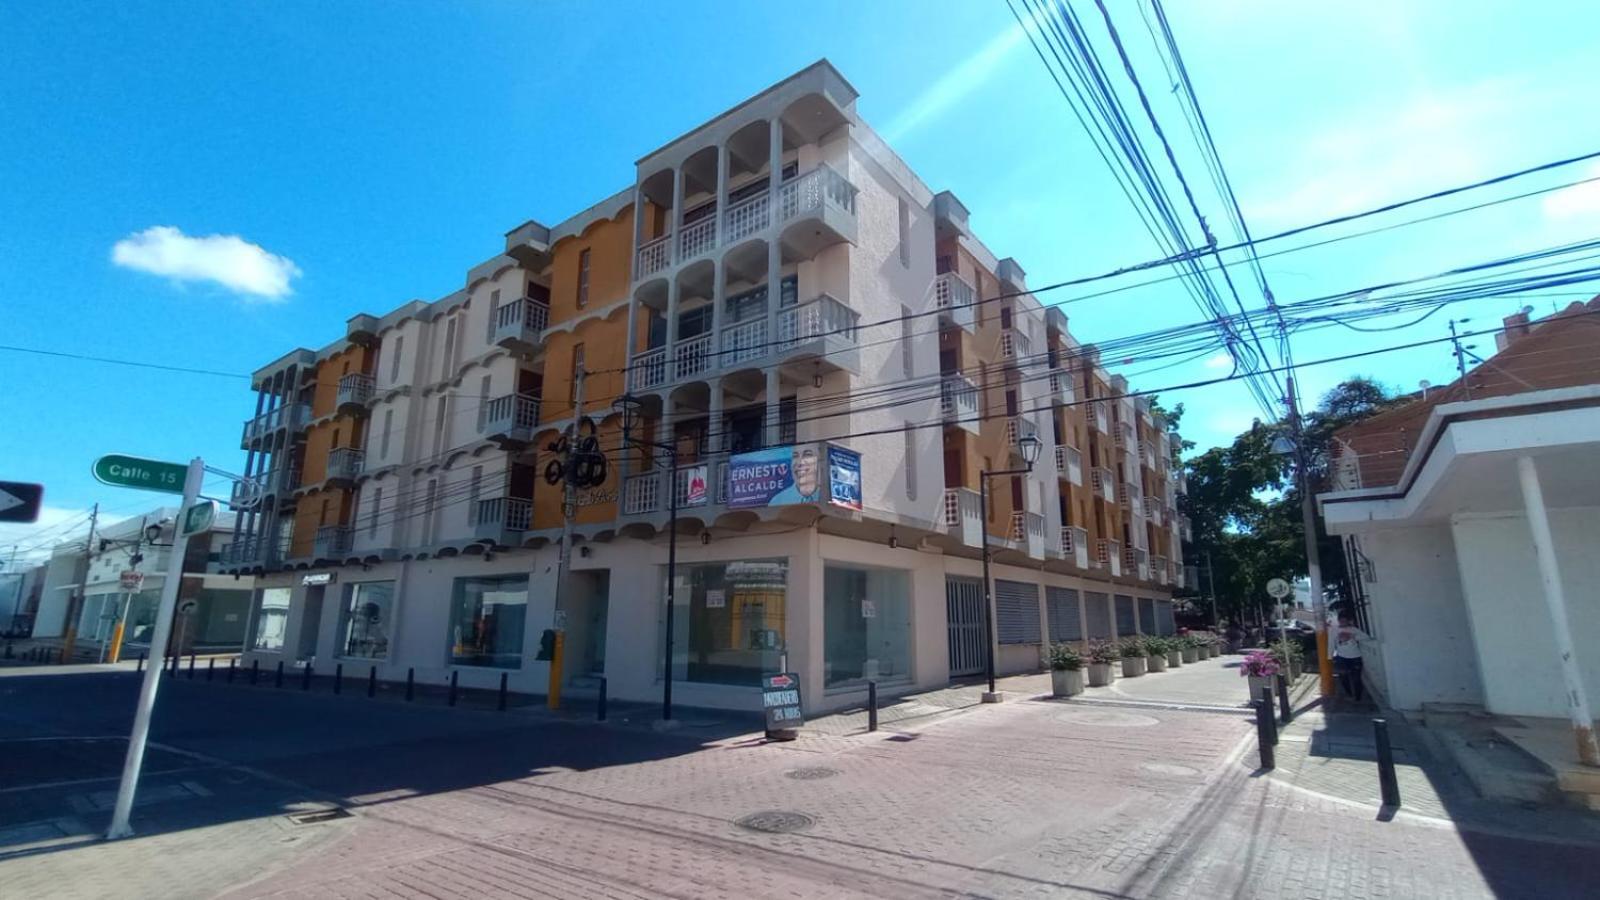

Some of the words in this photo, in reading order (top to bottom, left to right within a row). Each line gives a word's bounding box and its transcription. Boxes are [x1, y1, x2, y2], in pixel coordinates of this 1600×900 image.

[109, 464, 150, 480] Calle
[159, 472, 176, 484] 15
[734, 479, 784, 494] ALCALDE
